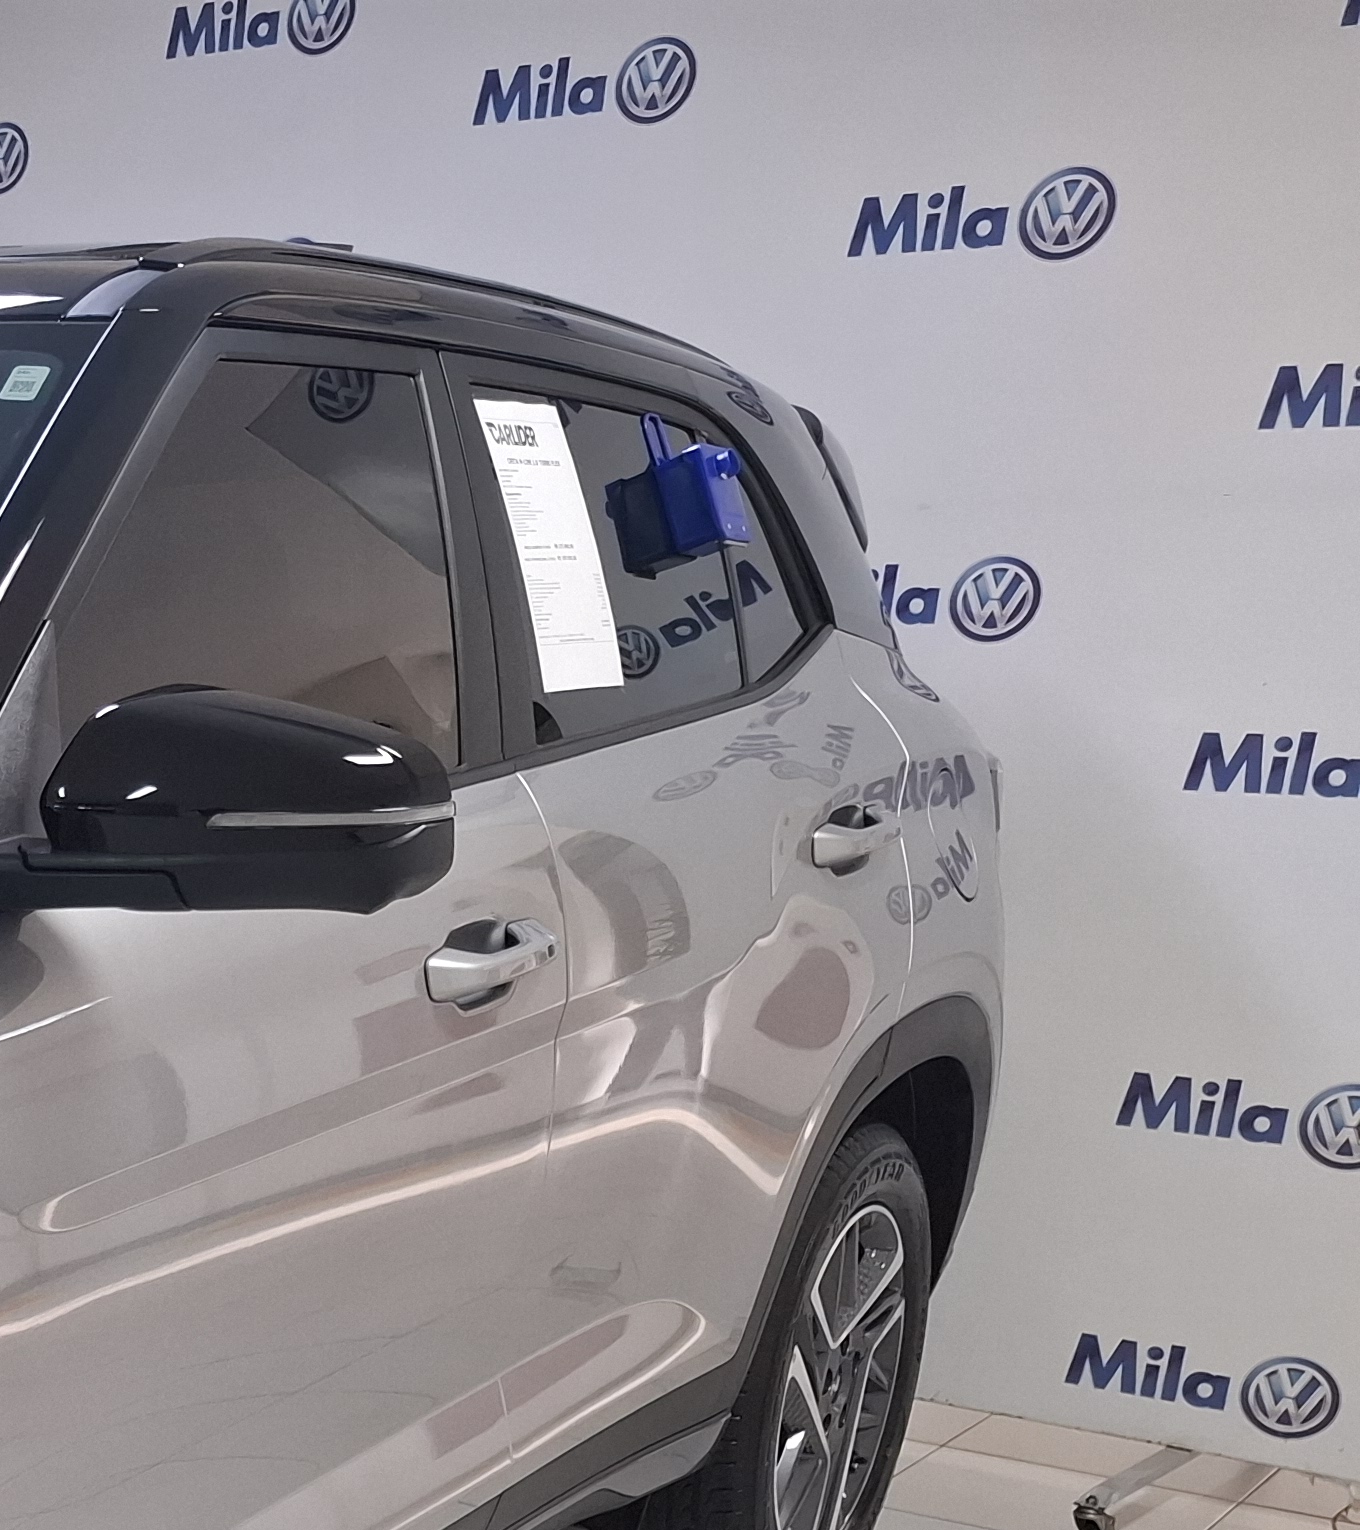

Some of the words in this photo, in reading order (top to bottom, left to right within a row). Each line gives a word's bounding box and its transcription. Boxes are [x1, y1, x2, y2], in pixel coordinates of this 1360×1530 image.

[166, 0, 279, 59] Mila
[473, 57, 607, 125] Mila
[848, 186, 1009, 257] Mila
[485, 422, 539, 447] CARLIDER
[873, 564, 940, 624] la
[1183, 732, 1360, 797] Mila
[1116, 1072, 1289, 1144] Mila
[1065, 1333, 1230, 1410] Mila
